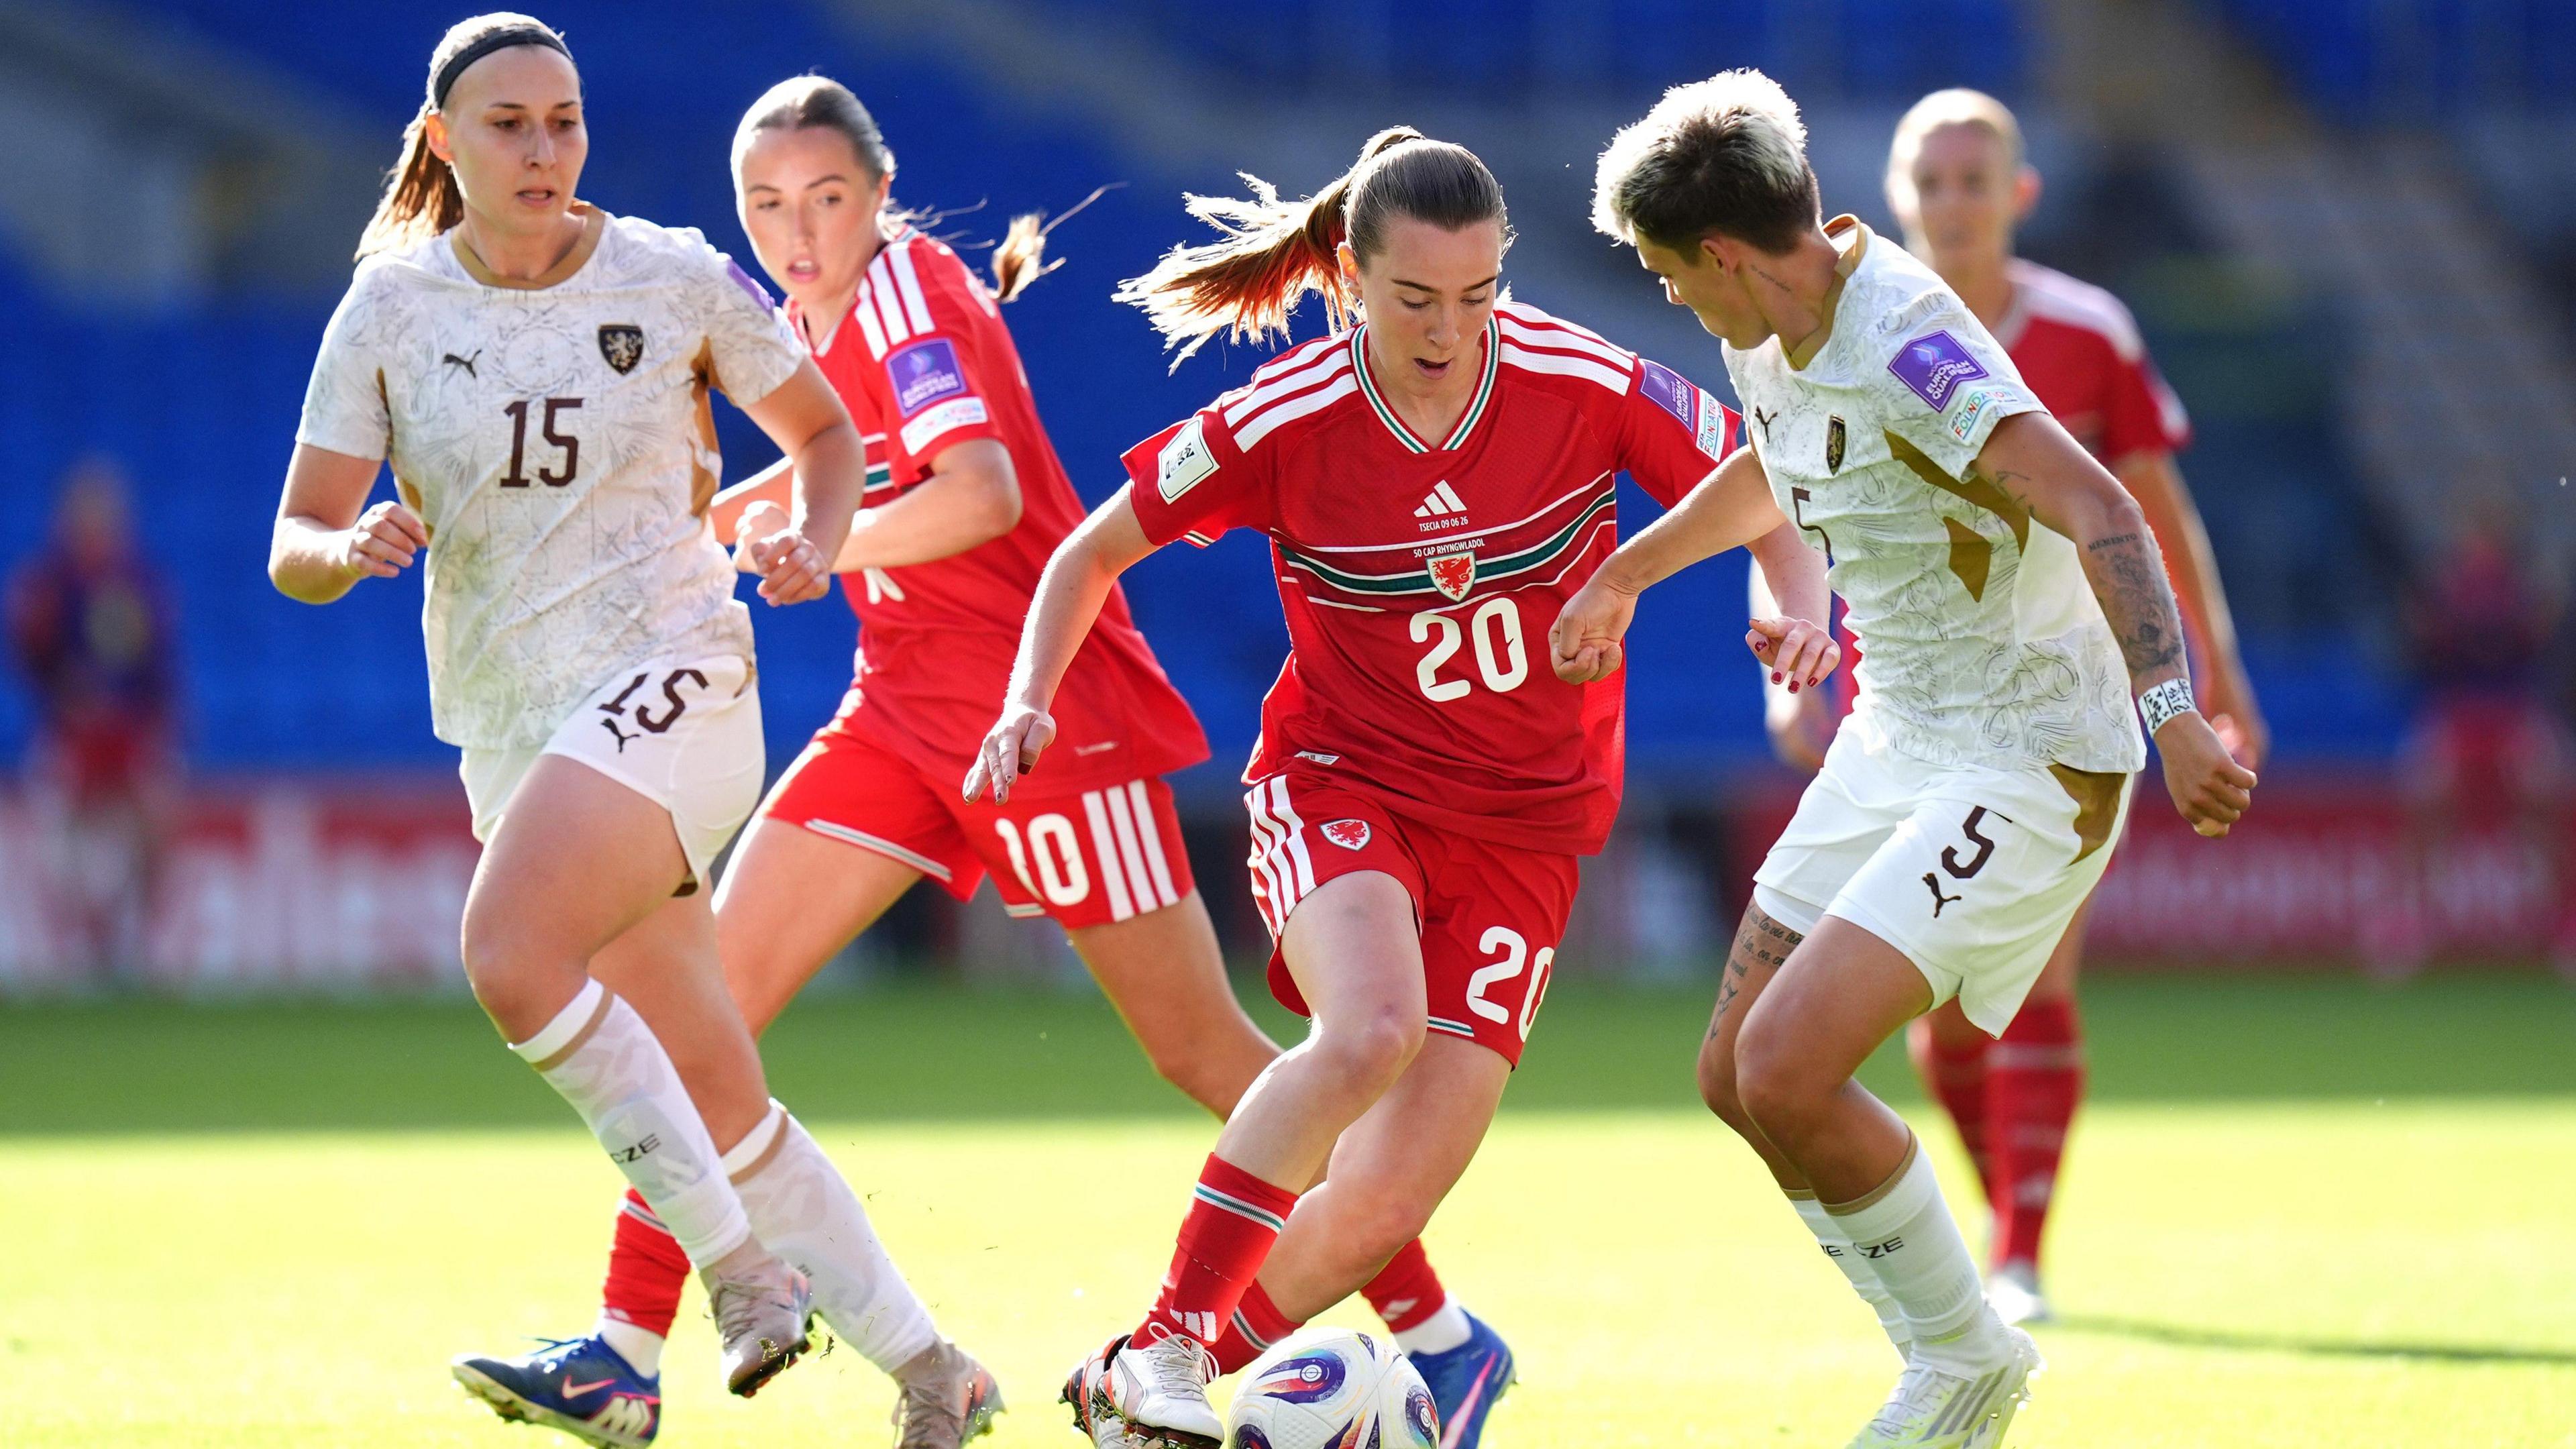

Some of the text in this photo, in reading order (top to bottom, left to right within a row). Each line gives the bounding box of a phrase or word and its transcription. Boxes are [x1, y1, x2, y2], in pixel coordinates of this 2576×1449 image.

[1925, 360, 1970, 393] EUROPEAN
[1932, 366, 1977, 400] QUALIFIERS
[499, 397, 586, 488] 15
[1413, 538, 1485, 558] 50 CAP RHYNGWLADOL
[1418, 516, 1469, 533] TSECIA 09 06 26
[1409, 597, 1529, 702] 20
[596, 669, 710, 733] 15
[994, 812, 1090, 906] 10
[1940, 805, 2013, 879] 5
[1466, 926, 1555, 1043] 20
[610, 1132, 661, 1165] CZE
[1852, 1236, 1904, 1258] CZE
